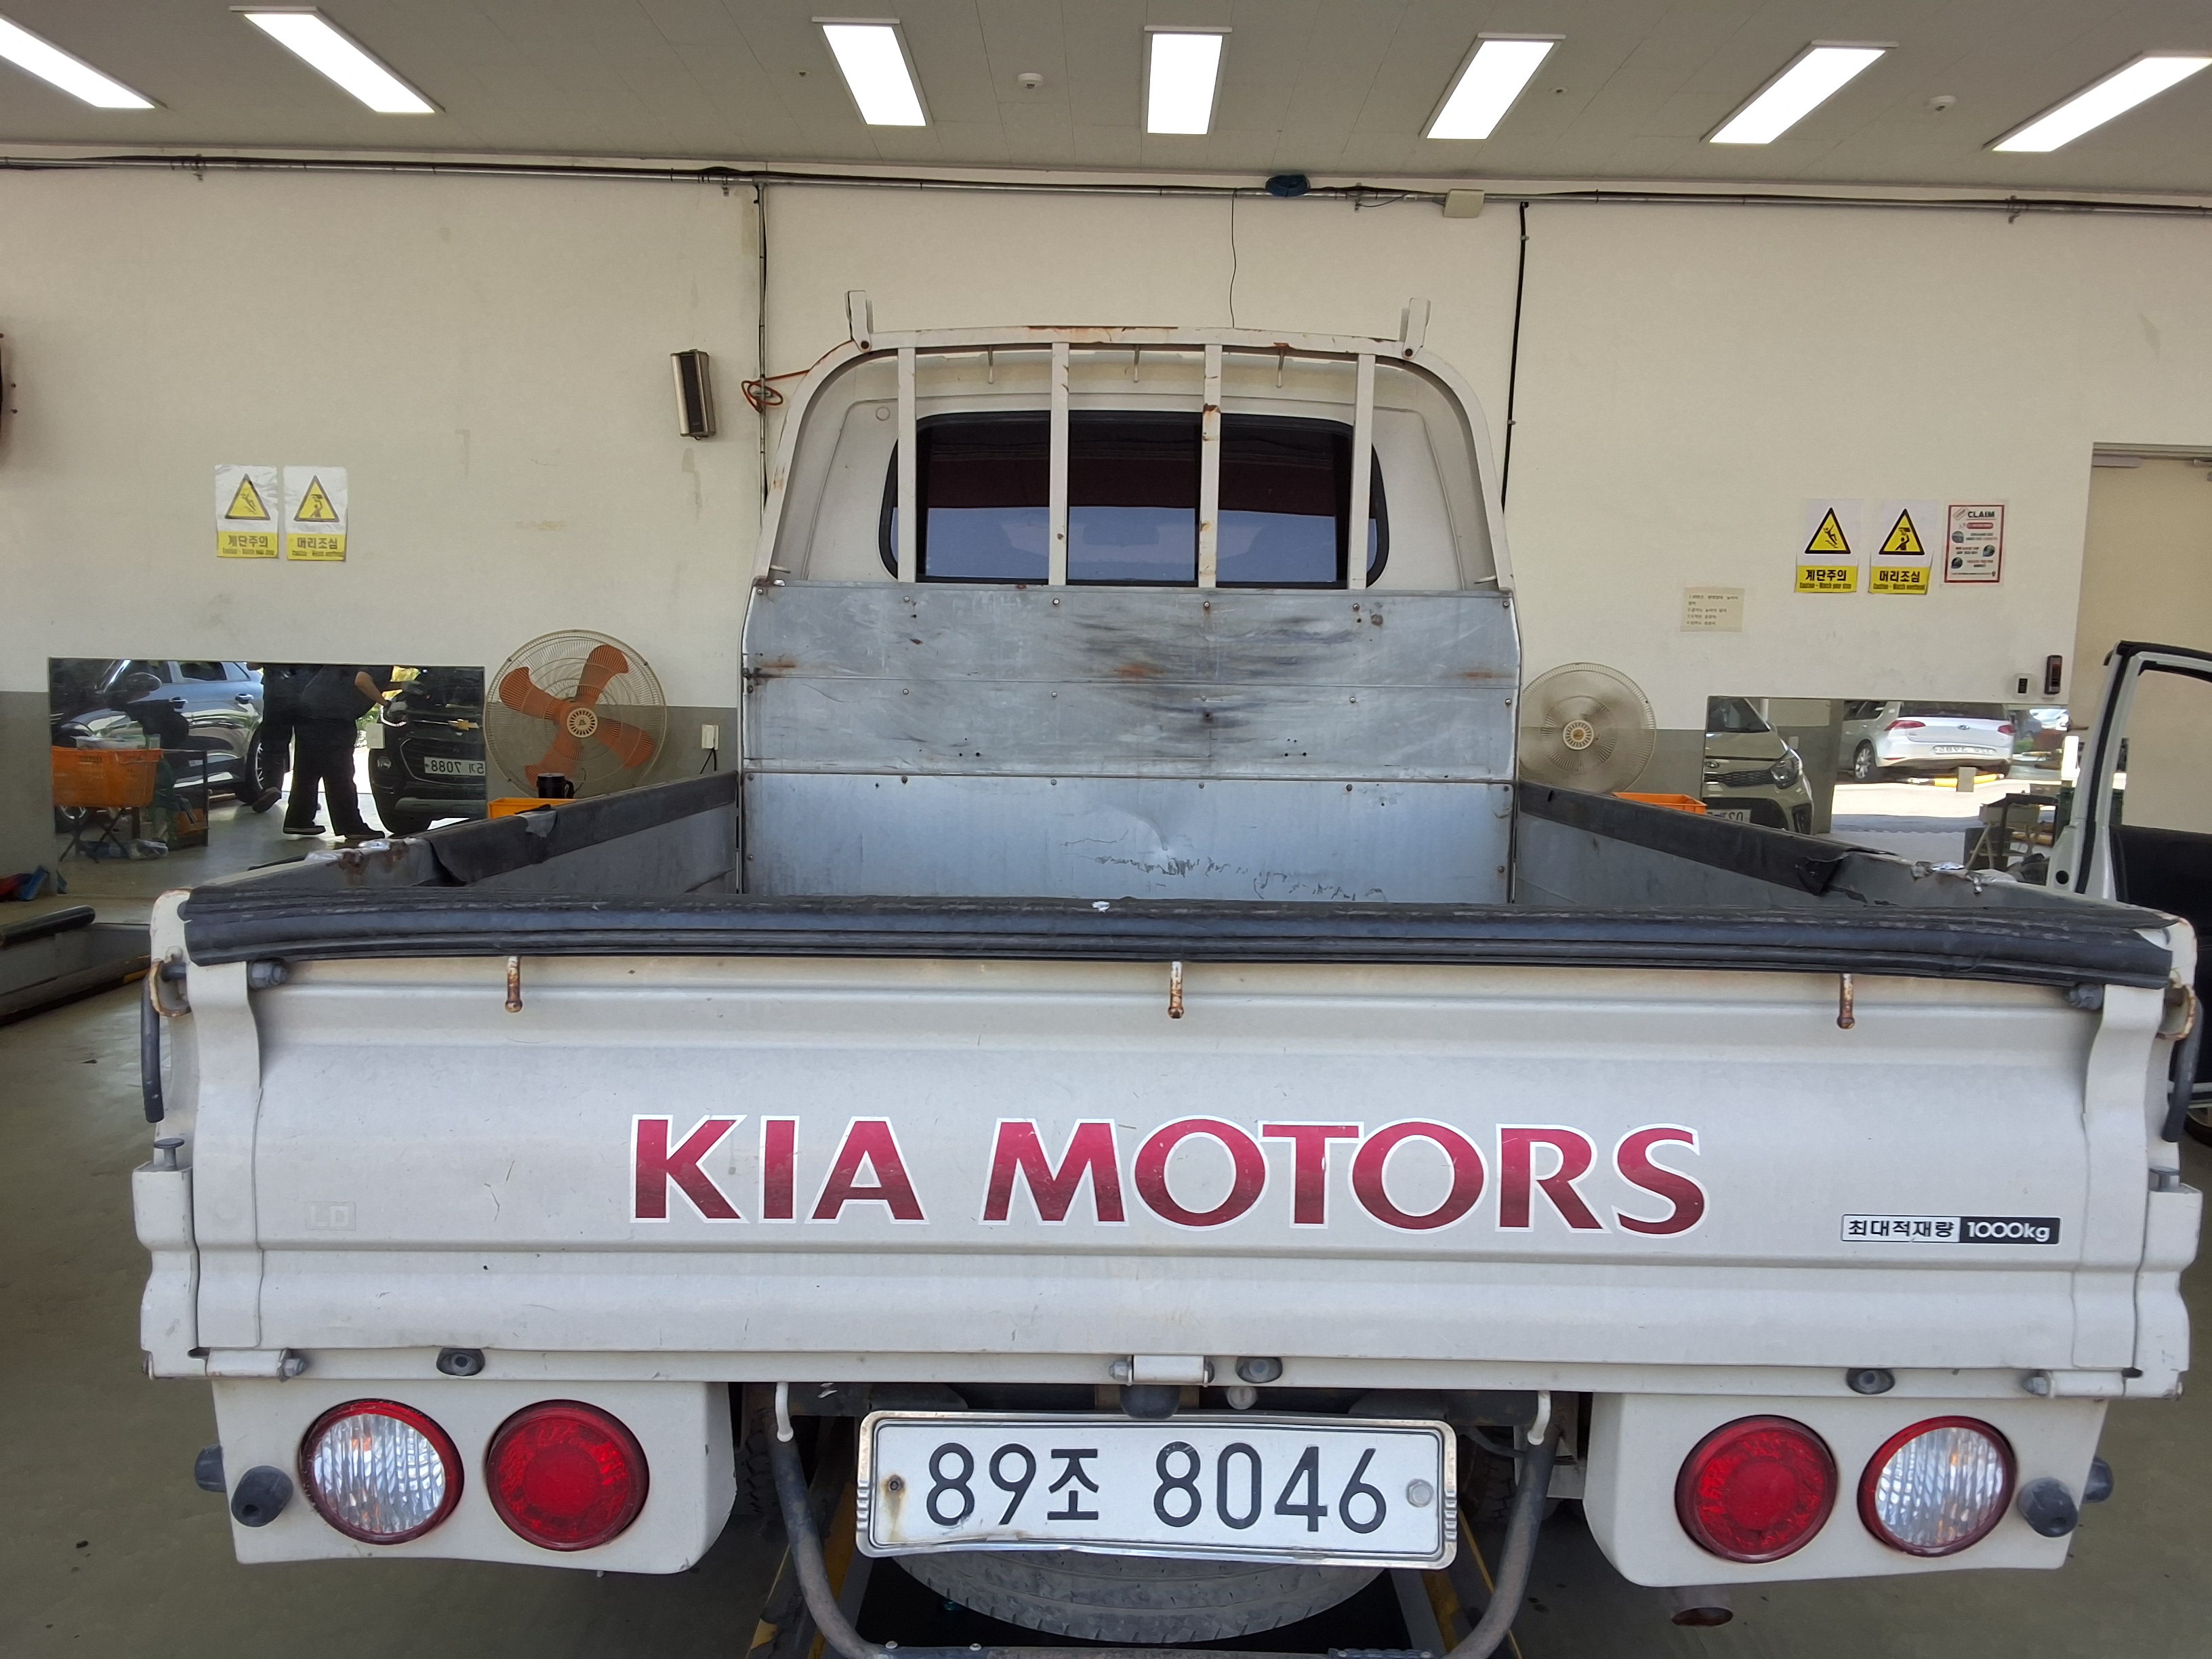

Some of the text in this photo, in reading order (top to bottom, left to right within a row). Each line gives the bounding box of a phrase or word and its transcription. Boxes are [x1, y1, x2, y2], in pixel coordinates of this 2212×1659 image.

[298, 537, 337, 550] 머리조심
[1805, 569, 1847, 581] 계단주의
[1879, 571, 1920, 583] 머리조심
[630, 1114, 1710, 1239] KIA MOTORS
[1848, 1220, 2051, 1242] 최대적재량 1000kg
[926, 1441, 1387, 1534] 89조 8046
